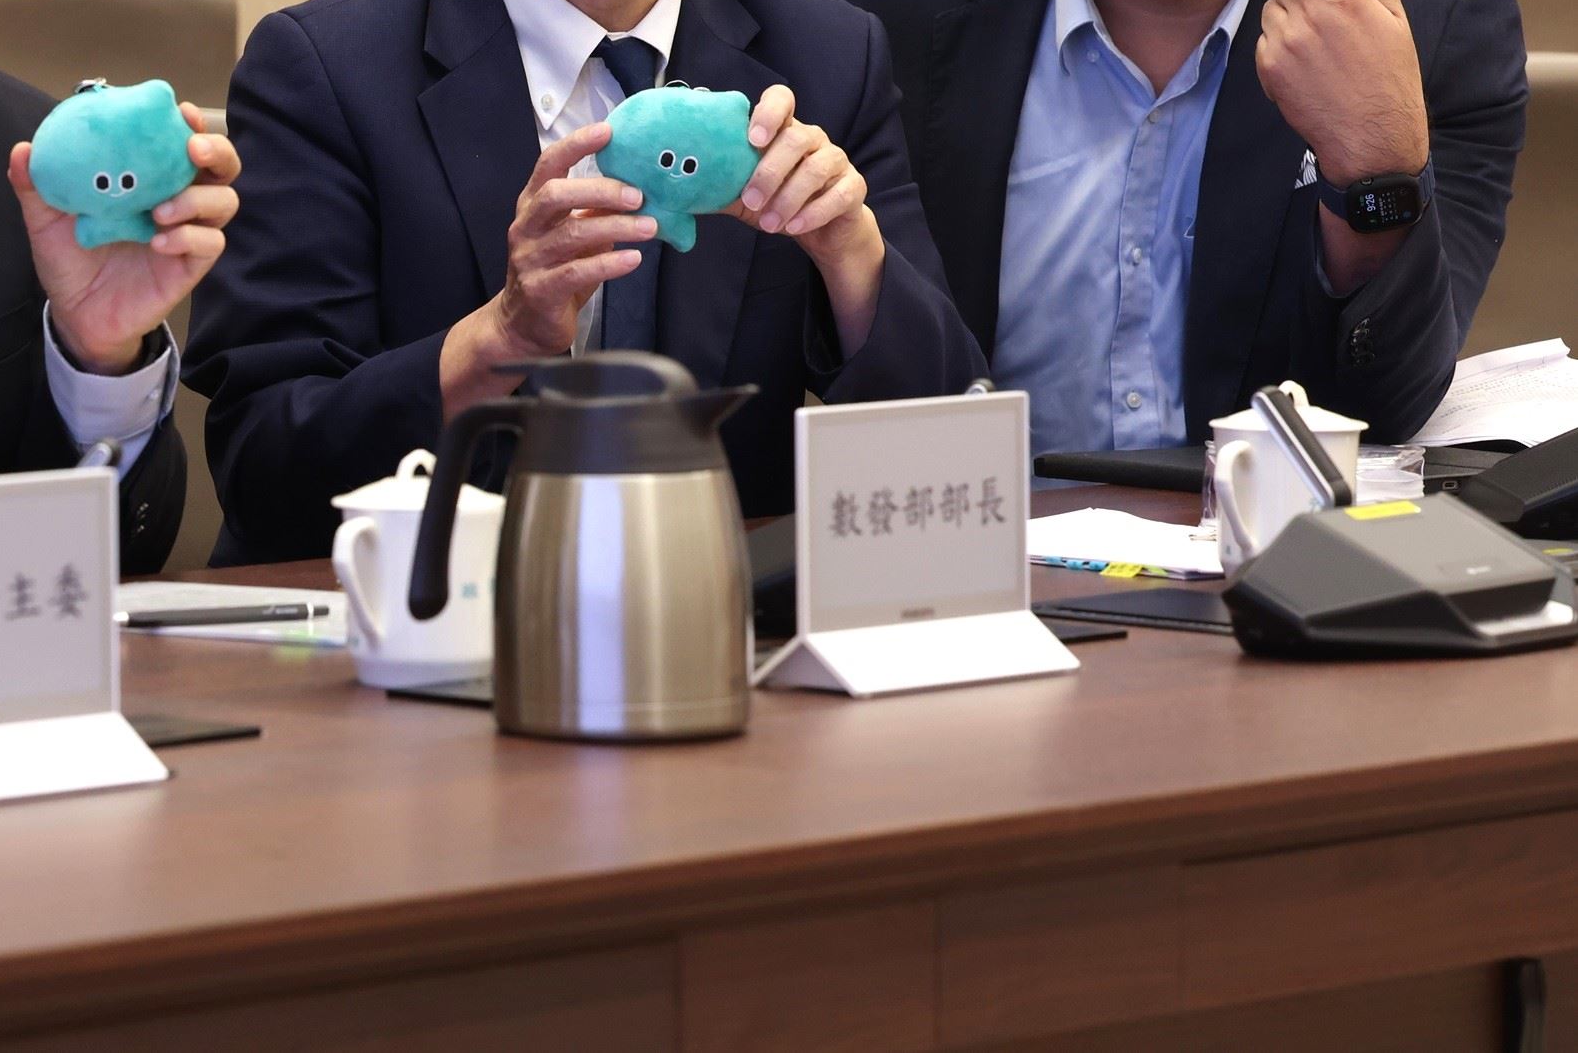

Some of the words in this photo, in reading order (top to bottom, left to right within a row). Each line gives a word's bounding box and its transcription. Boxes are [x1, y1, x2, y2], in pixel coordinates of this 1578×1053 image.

[1365, 193, 1376, 211] 9:26
[830, 475, 1006, 538] 數發部部長
